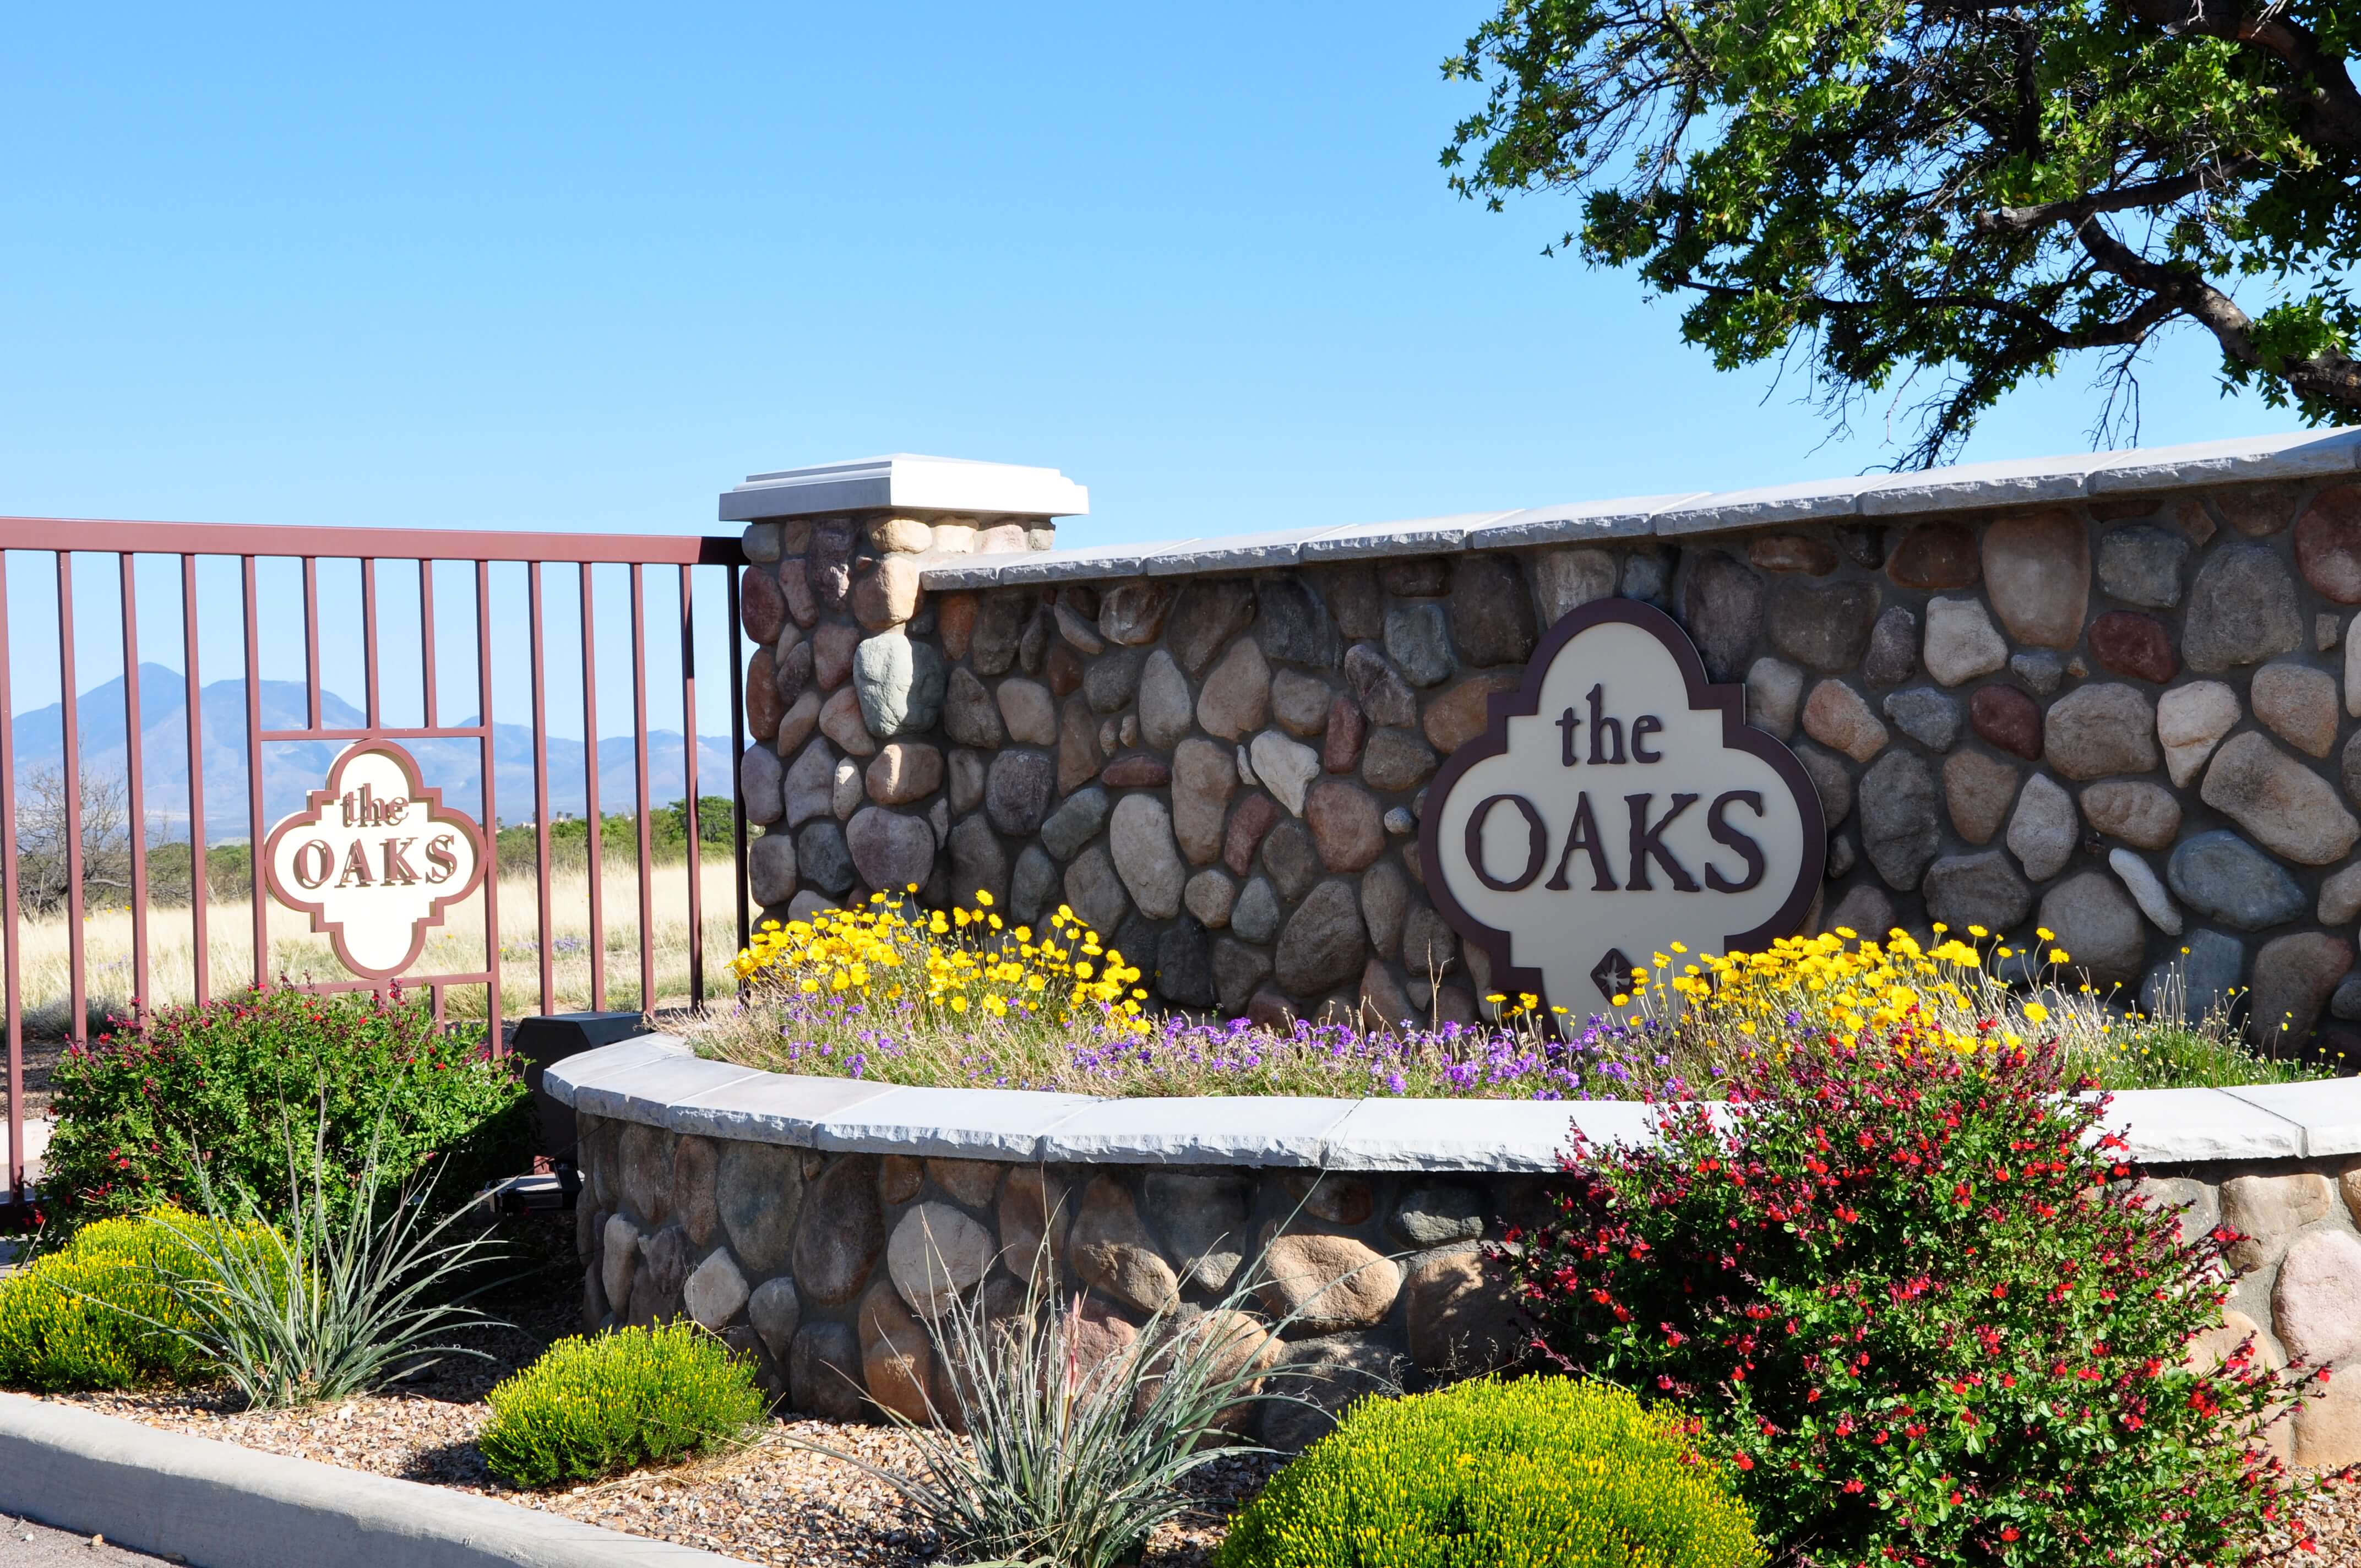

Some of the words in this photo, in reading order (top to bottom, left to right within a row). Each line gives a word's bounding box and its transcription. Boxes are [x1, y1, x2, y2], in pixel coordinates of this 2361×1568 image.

[1555, 683, 1661, 766] the
[345, 783, 409, 824] the
[295, 835, 458, 887] OAKS
[1465, 790, 1765, 894] OAKS
